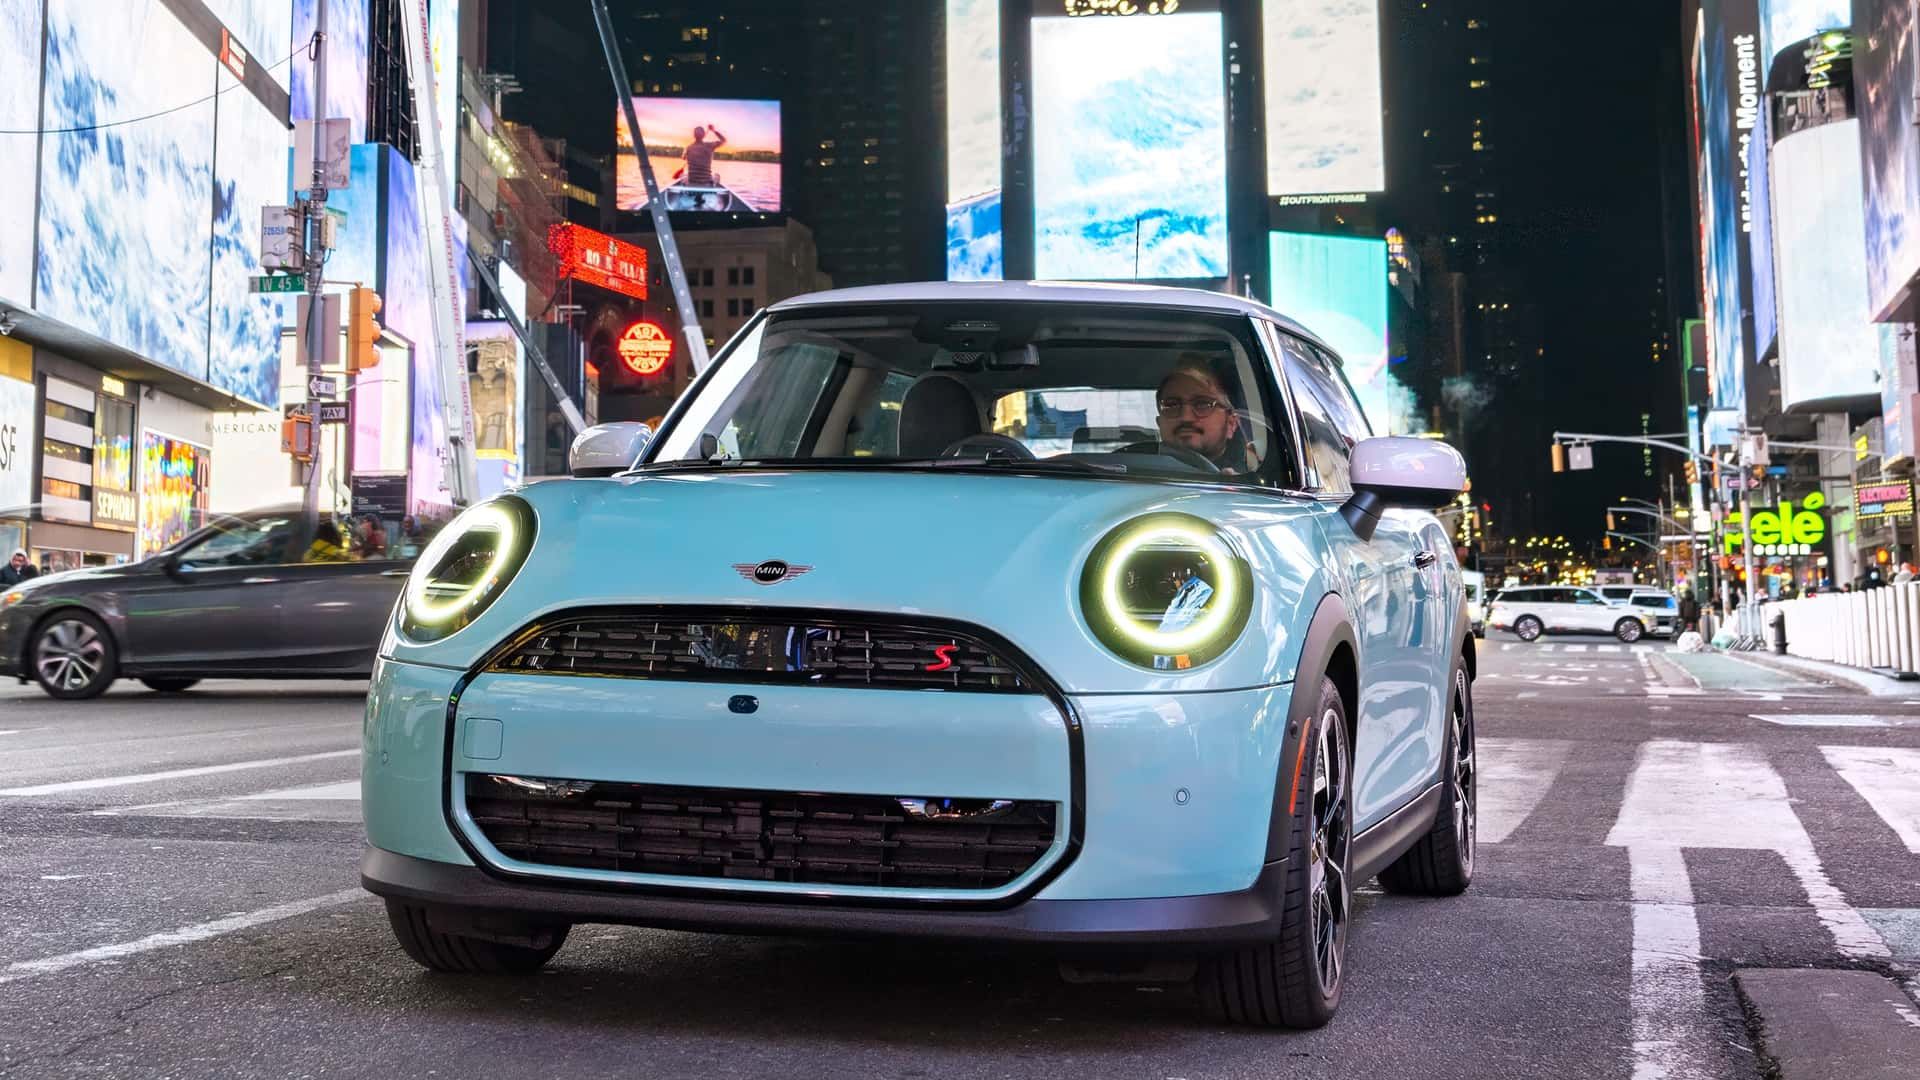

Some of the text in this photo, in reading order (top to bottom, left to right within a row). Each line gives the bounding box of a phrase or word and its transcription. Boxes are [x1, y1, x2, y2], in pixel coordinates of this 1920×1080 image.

[1733, 34, 1758, 129] Moment
[262, 278, 272, 291] W
[278, 278, 292, 291] 45
[633, 327, 659, 339] HOT
[633, 356, 662, 369] NOW
[321, 407, 341, 418] WAY
[97, 492, 136, 521] SEPHORA
[757, 567, 785, 575] MINI
[926, 645, 957, 671] S
